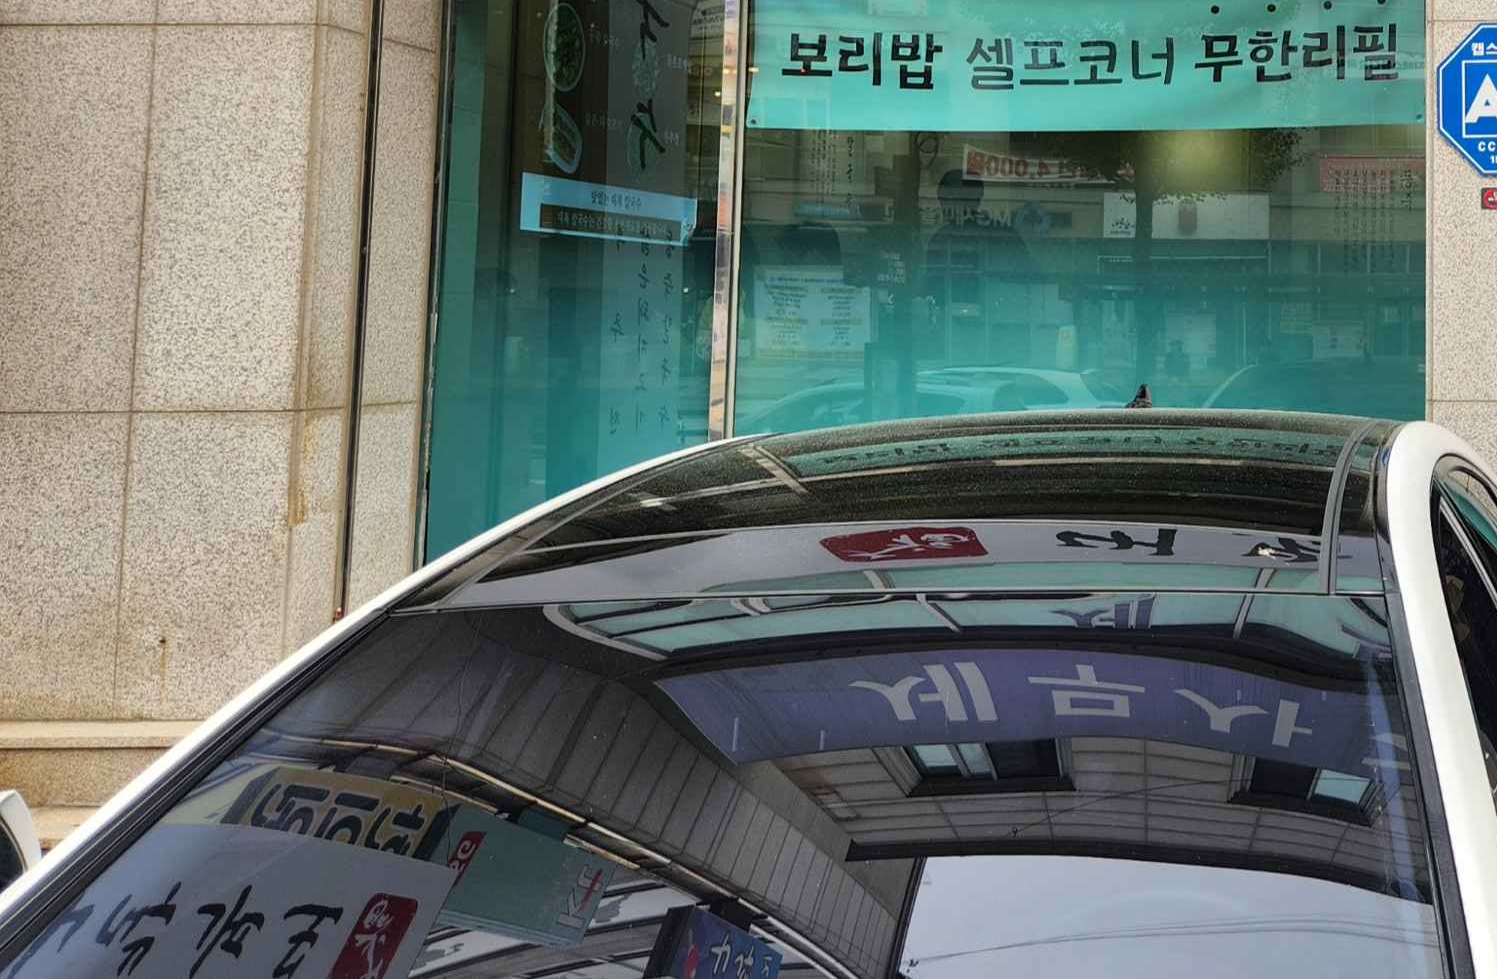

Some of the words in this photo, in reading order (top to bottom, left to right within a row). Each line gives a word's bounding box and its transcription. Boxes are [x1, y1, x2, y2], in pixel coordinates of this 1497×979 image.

[781, 31, 943, 91] 보리밥
[965, 36, 1176, 91] 셀프코너
[1194, 23, 1400, 83] 무한리필
